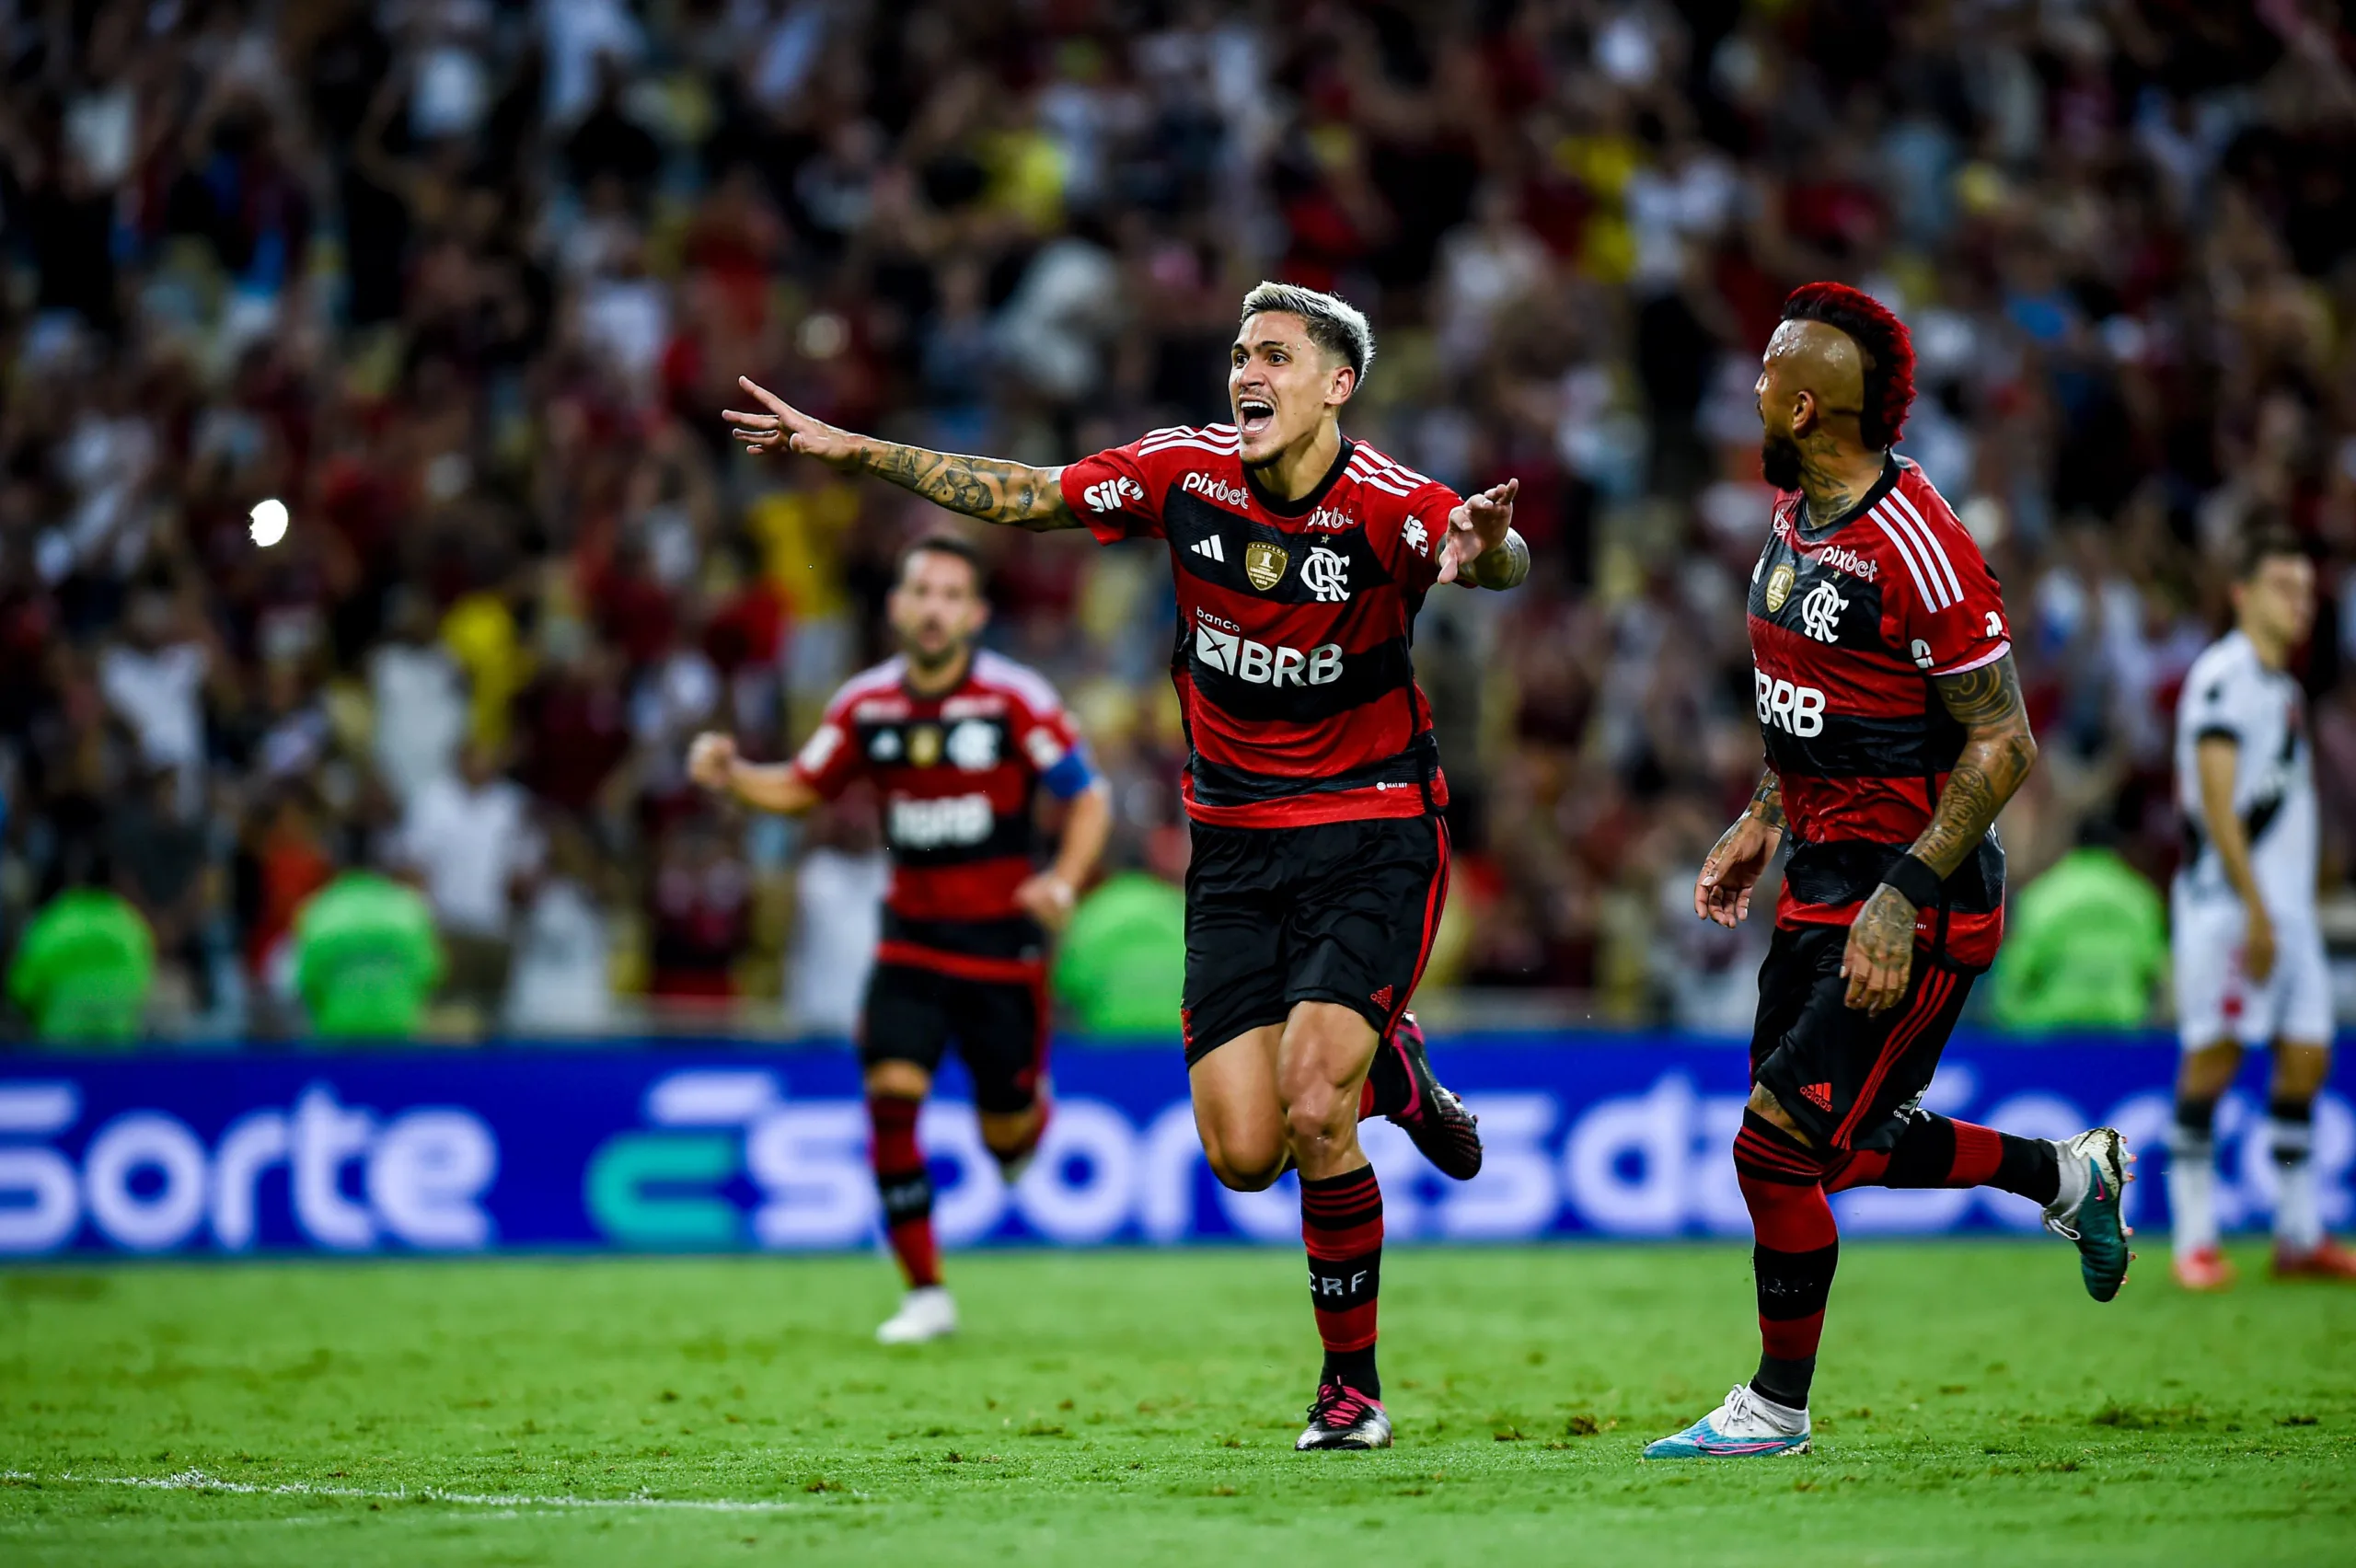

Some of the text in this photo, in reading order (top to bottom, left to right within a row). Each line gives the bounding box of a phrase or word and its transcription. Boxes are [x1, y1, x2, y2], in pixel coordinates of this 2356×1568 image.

[1182, 471, 1250, 510] pixbet
[1817, 545, 1878, 583] pixbet
[1196, 605, 1241, 632] banco
[1239, 639, 1344, 688] BRB
[1758, 672, 1826, 738] BRB
[1799, 1086, 1833, 1113] adidas
